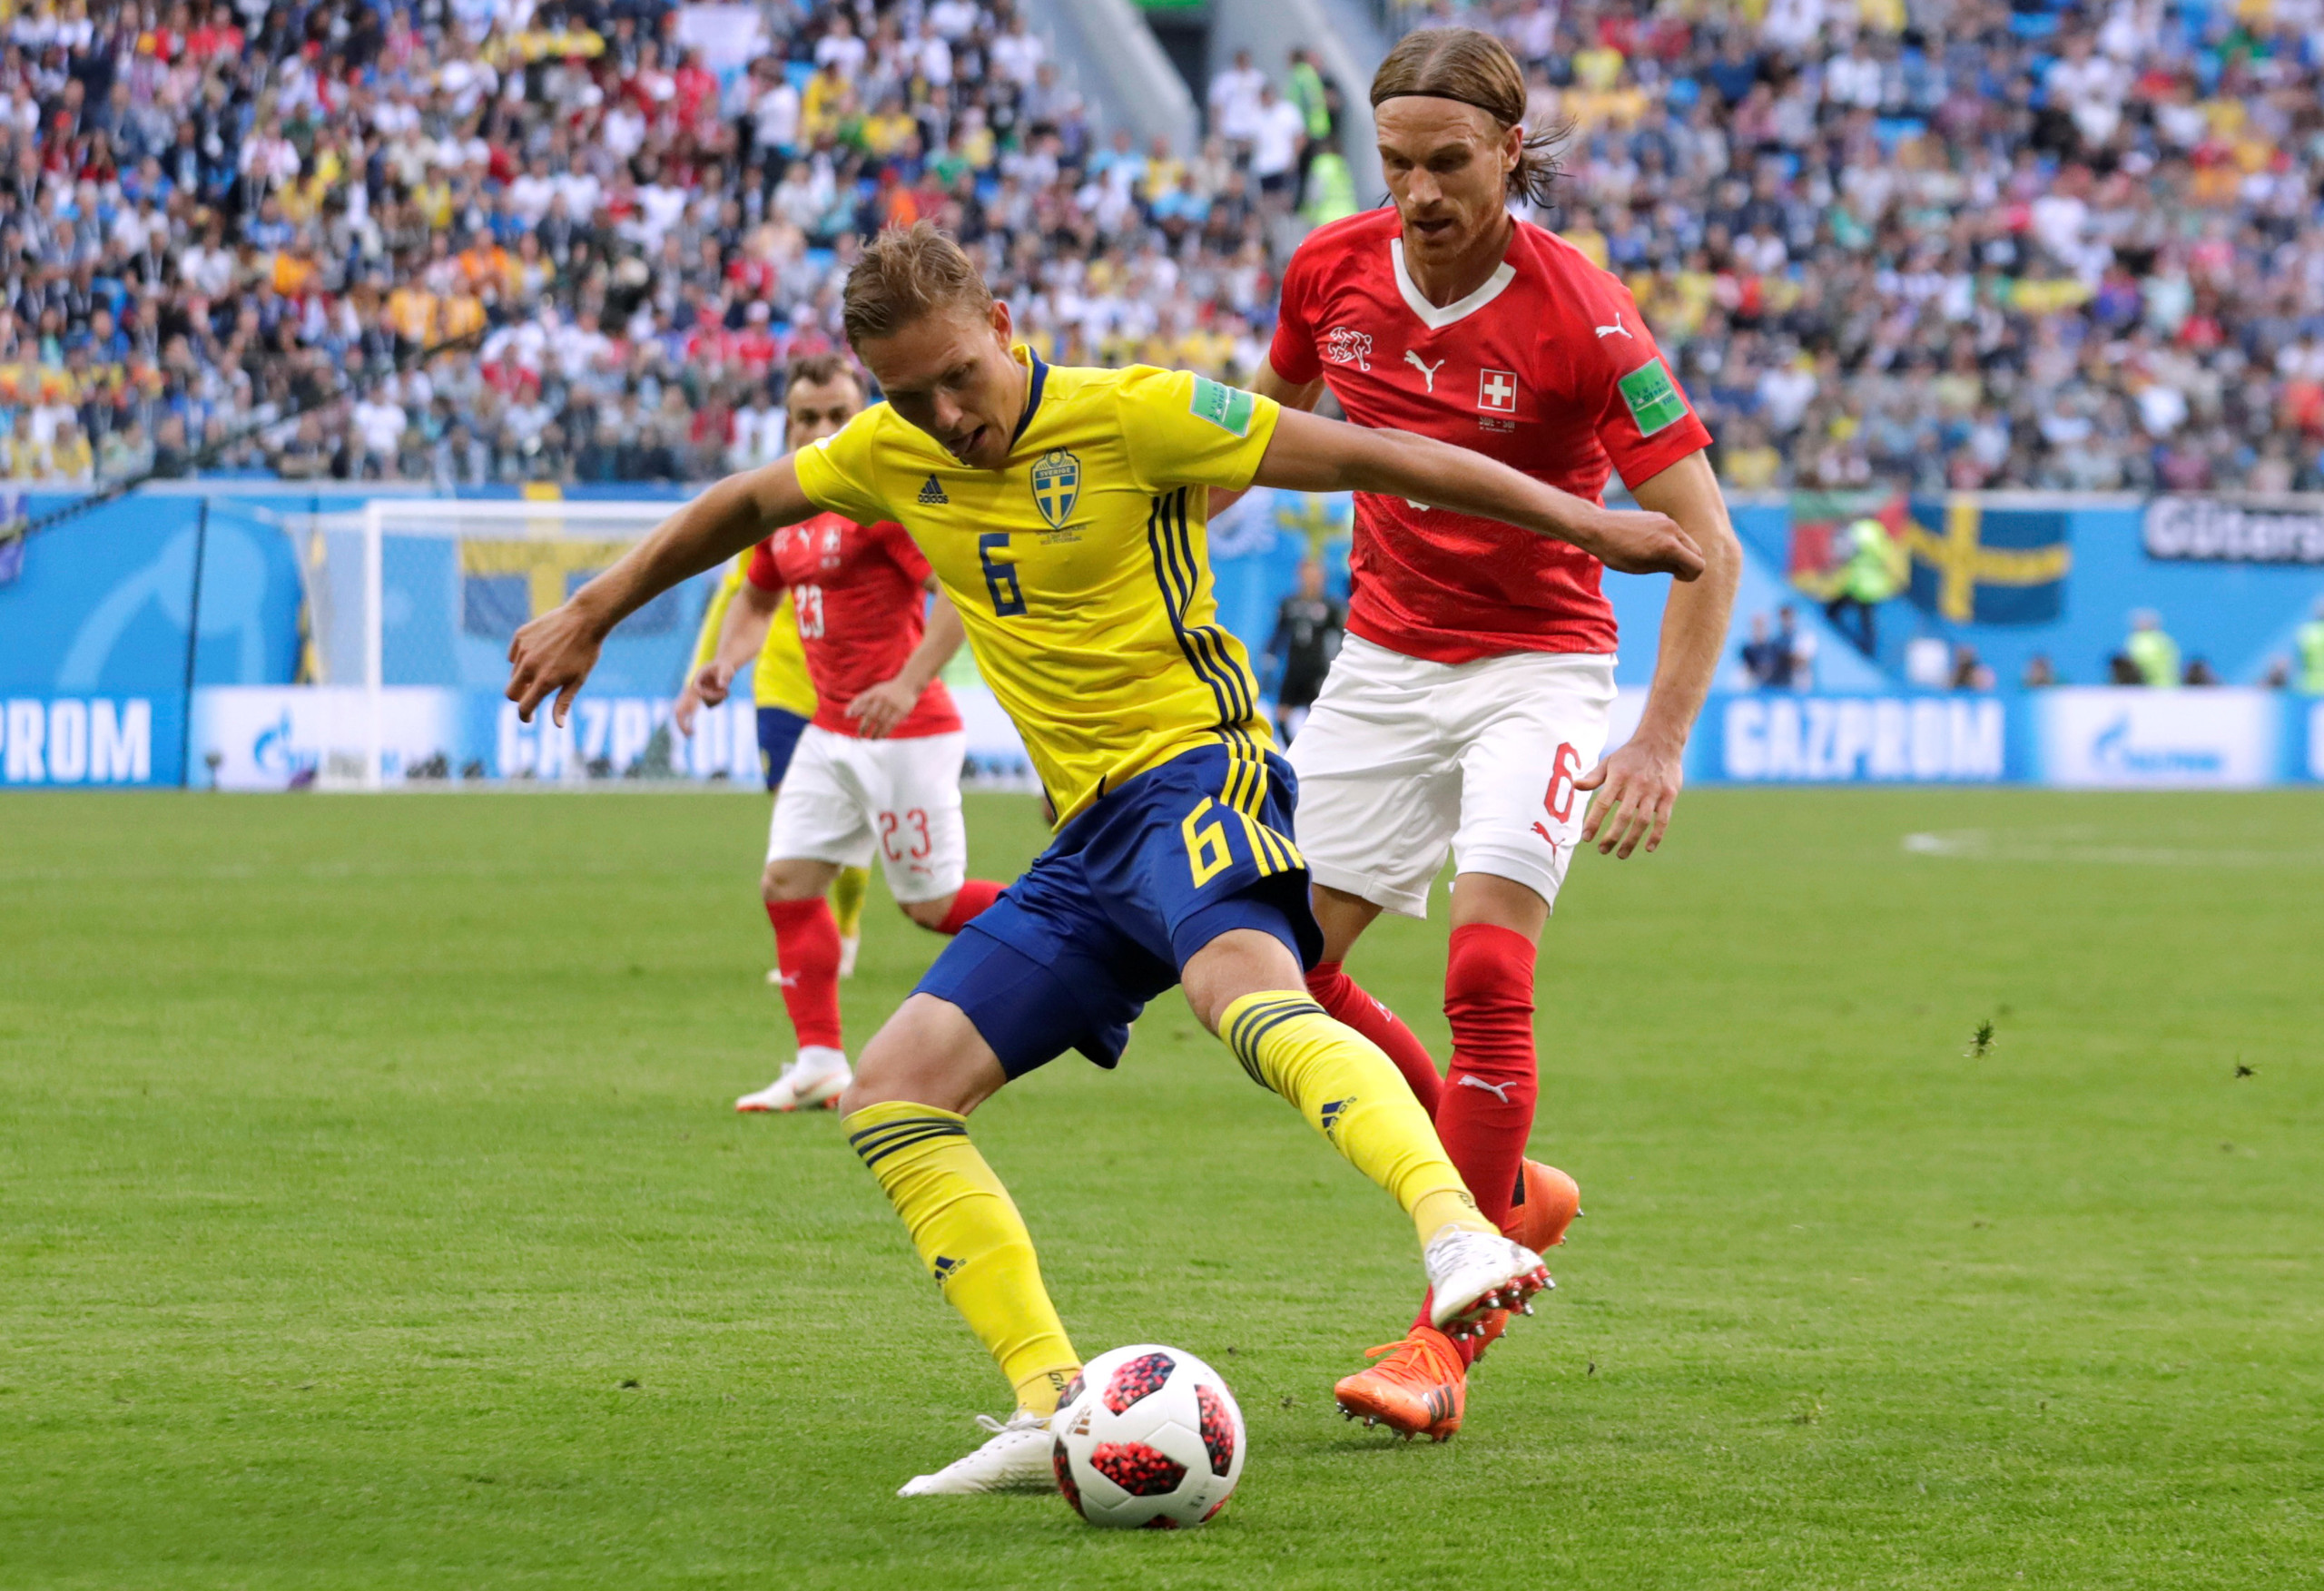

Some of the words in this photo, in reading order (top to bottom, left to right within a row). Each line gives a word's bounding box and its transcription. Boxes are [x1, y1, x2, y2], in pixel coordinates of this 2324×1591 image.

[918, 494, 949, 505] adidas
[1039, 466, 1072, 478] SVERIGE
[795, 584, 825, 639] 23
[980, 533, 1029, 618] 6
[0, 698, 152, 782] ROM
[1726, 697, 2005, 778] GAZPROM
[1544, 741, 1581, 824] 6
[879, 808, 931, 863] 23
[1182, 796, 1234, 889] 6
